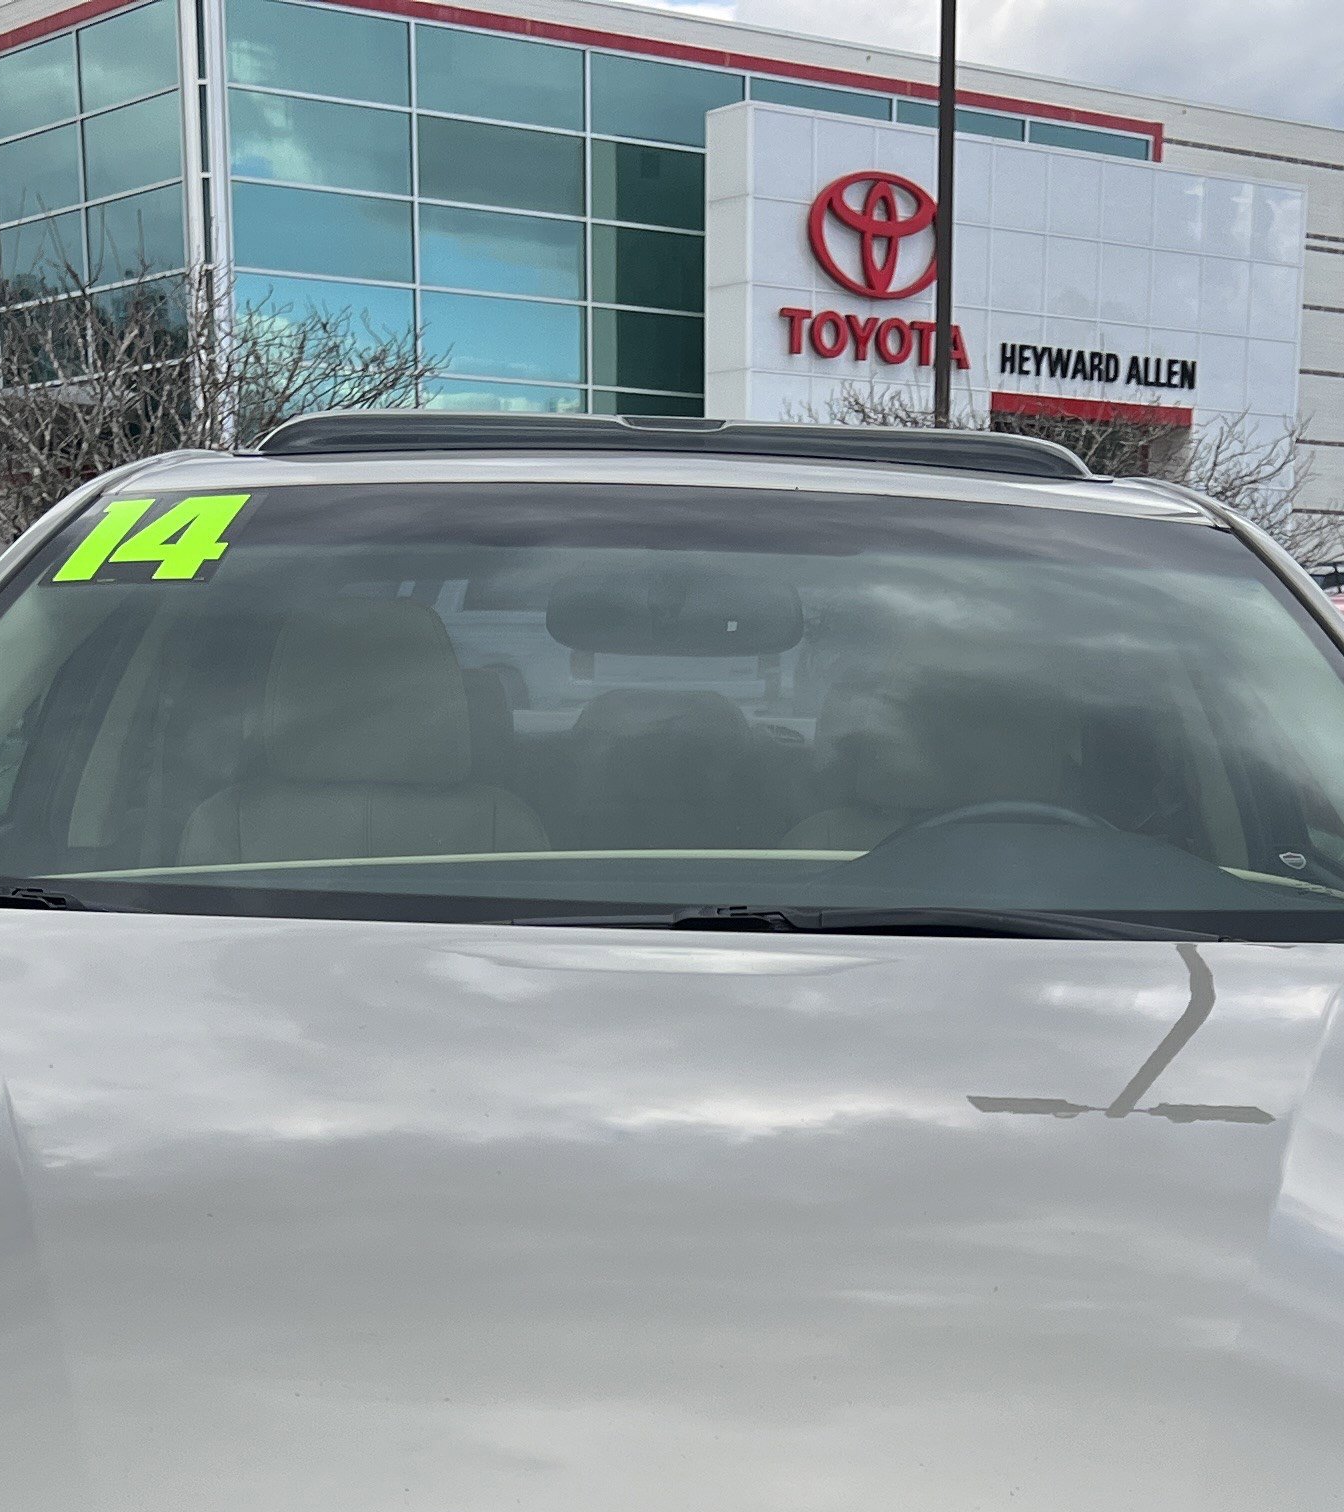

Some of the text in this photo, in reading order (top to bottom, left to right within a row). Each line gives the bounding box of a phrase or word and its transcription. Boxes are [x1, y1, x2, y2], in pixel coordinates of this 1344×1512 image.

[779, 307, 971, 370] TOYOTA
[1000, 342, 1197, 390] HEYWARD ALLEN
[52, 494, 251, 582] 14
